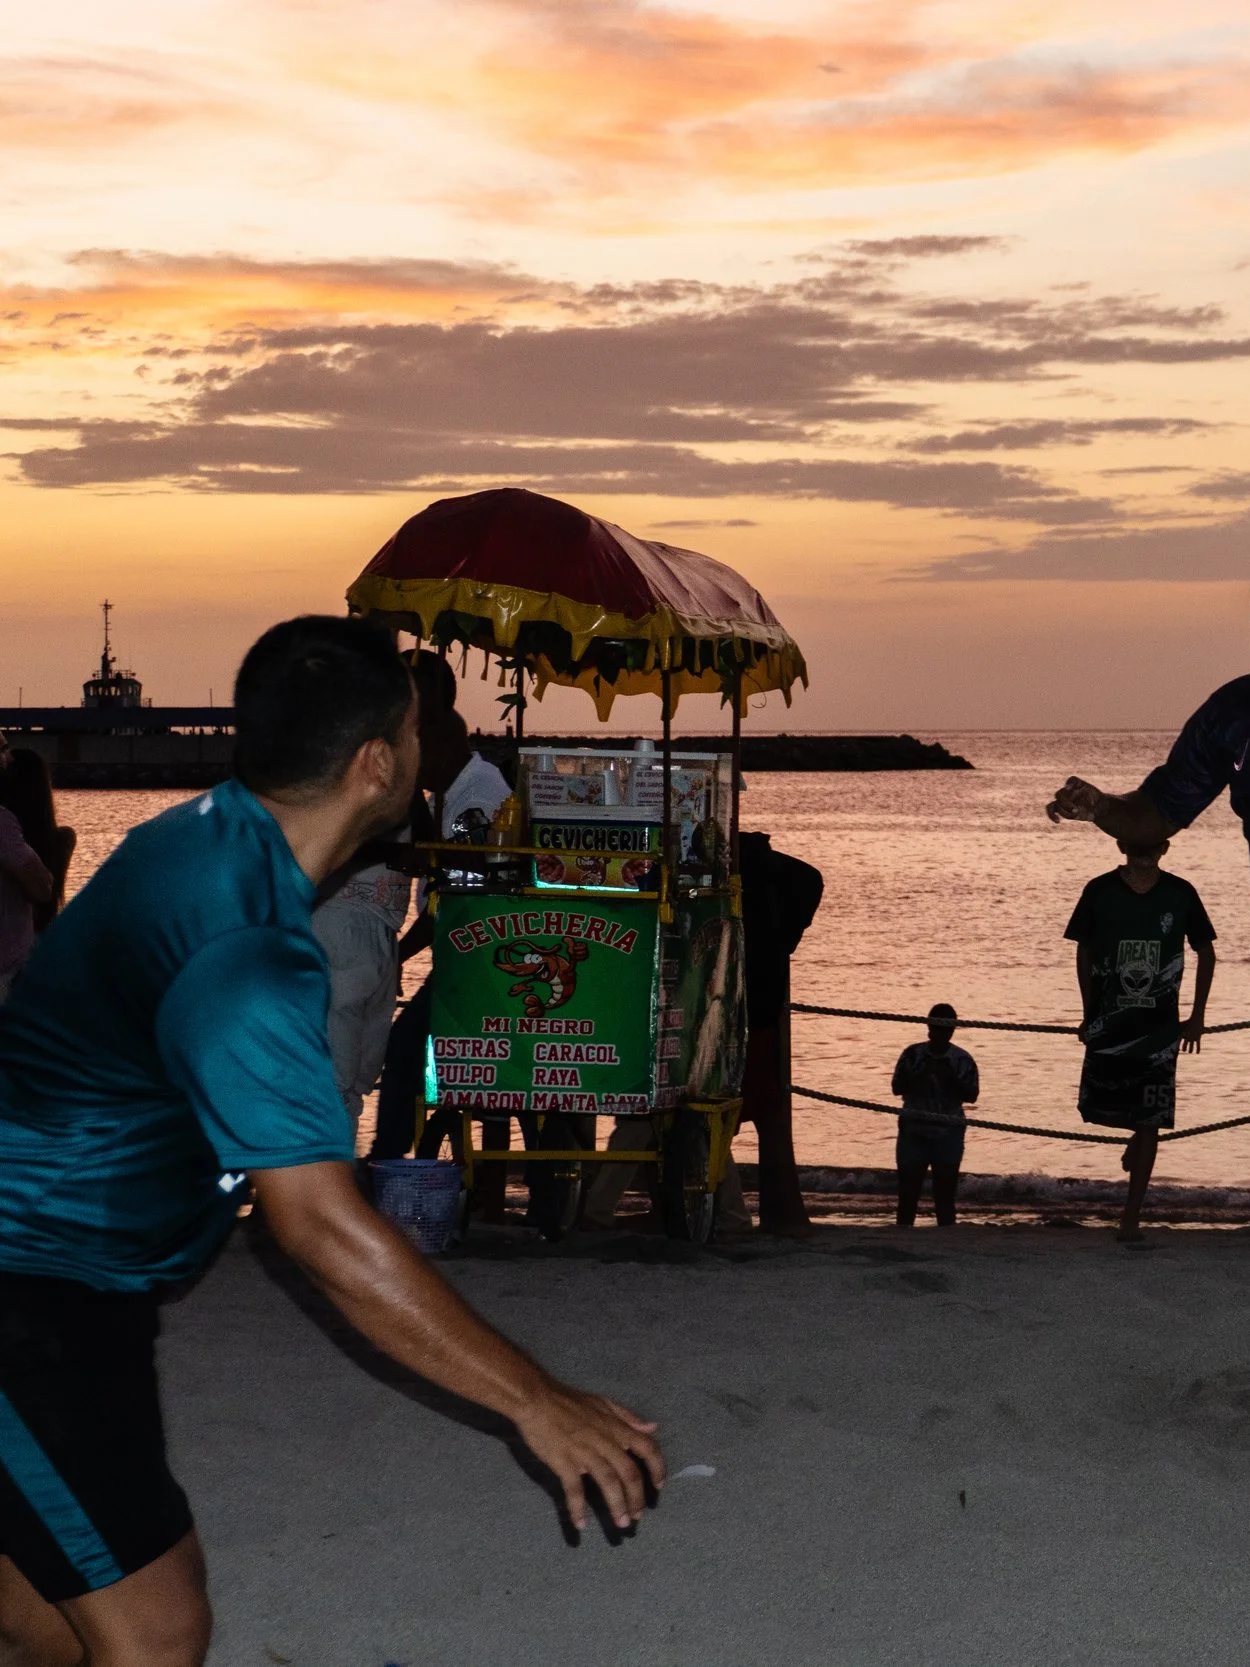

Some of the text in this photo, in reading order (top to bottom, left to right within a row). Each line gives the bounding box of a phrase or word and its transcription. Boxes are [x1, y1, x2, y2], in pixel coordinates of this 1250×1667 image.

[539, 827, 651, 852] CEVICHERIA
[448, 911, 640, 955] CEVICHERIA
[482, 1016, 595, 1035] MI NEGRO
[433, 1037, 511, 1061] OSTRAS
[533, 1043, 620, 1065] CARACOL
[436, 1063, 497, 1086] PULPO
[533, 1066, 581, 1088] RAYA
[437, 1089, 526, 1111] AMARON
[530, 1091, 598, 1114] MANTA
